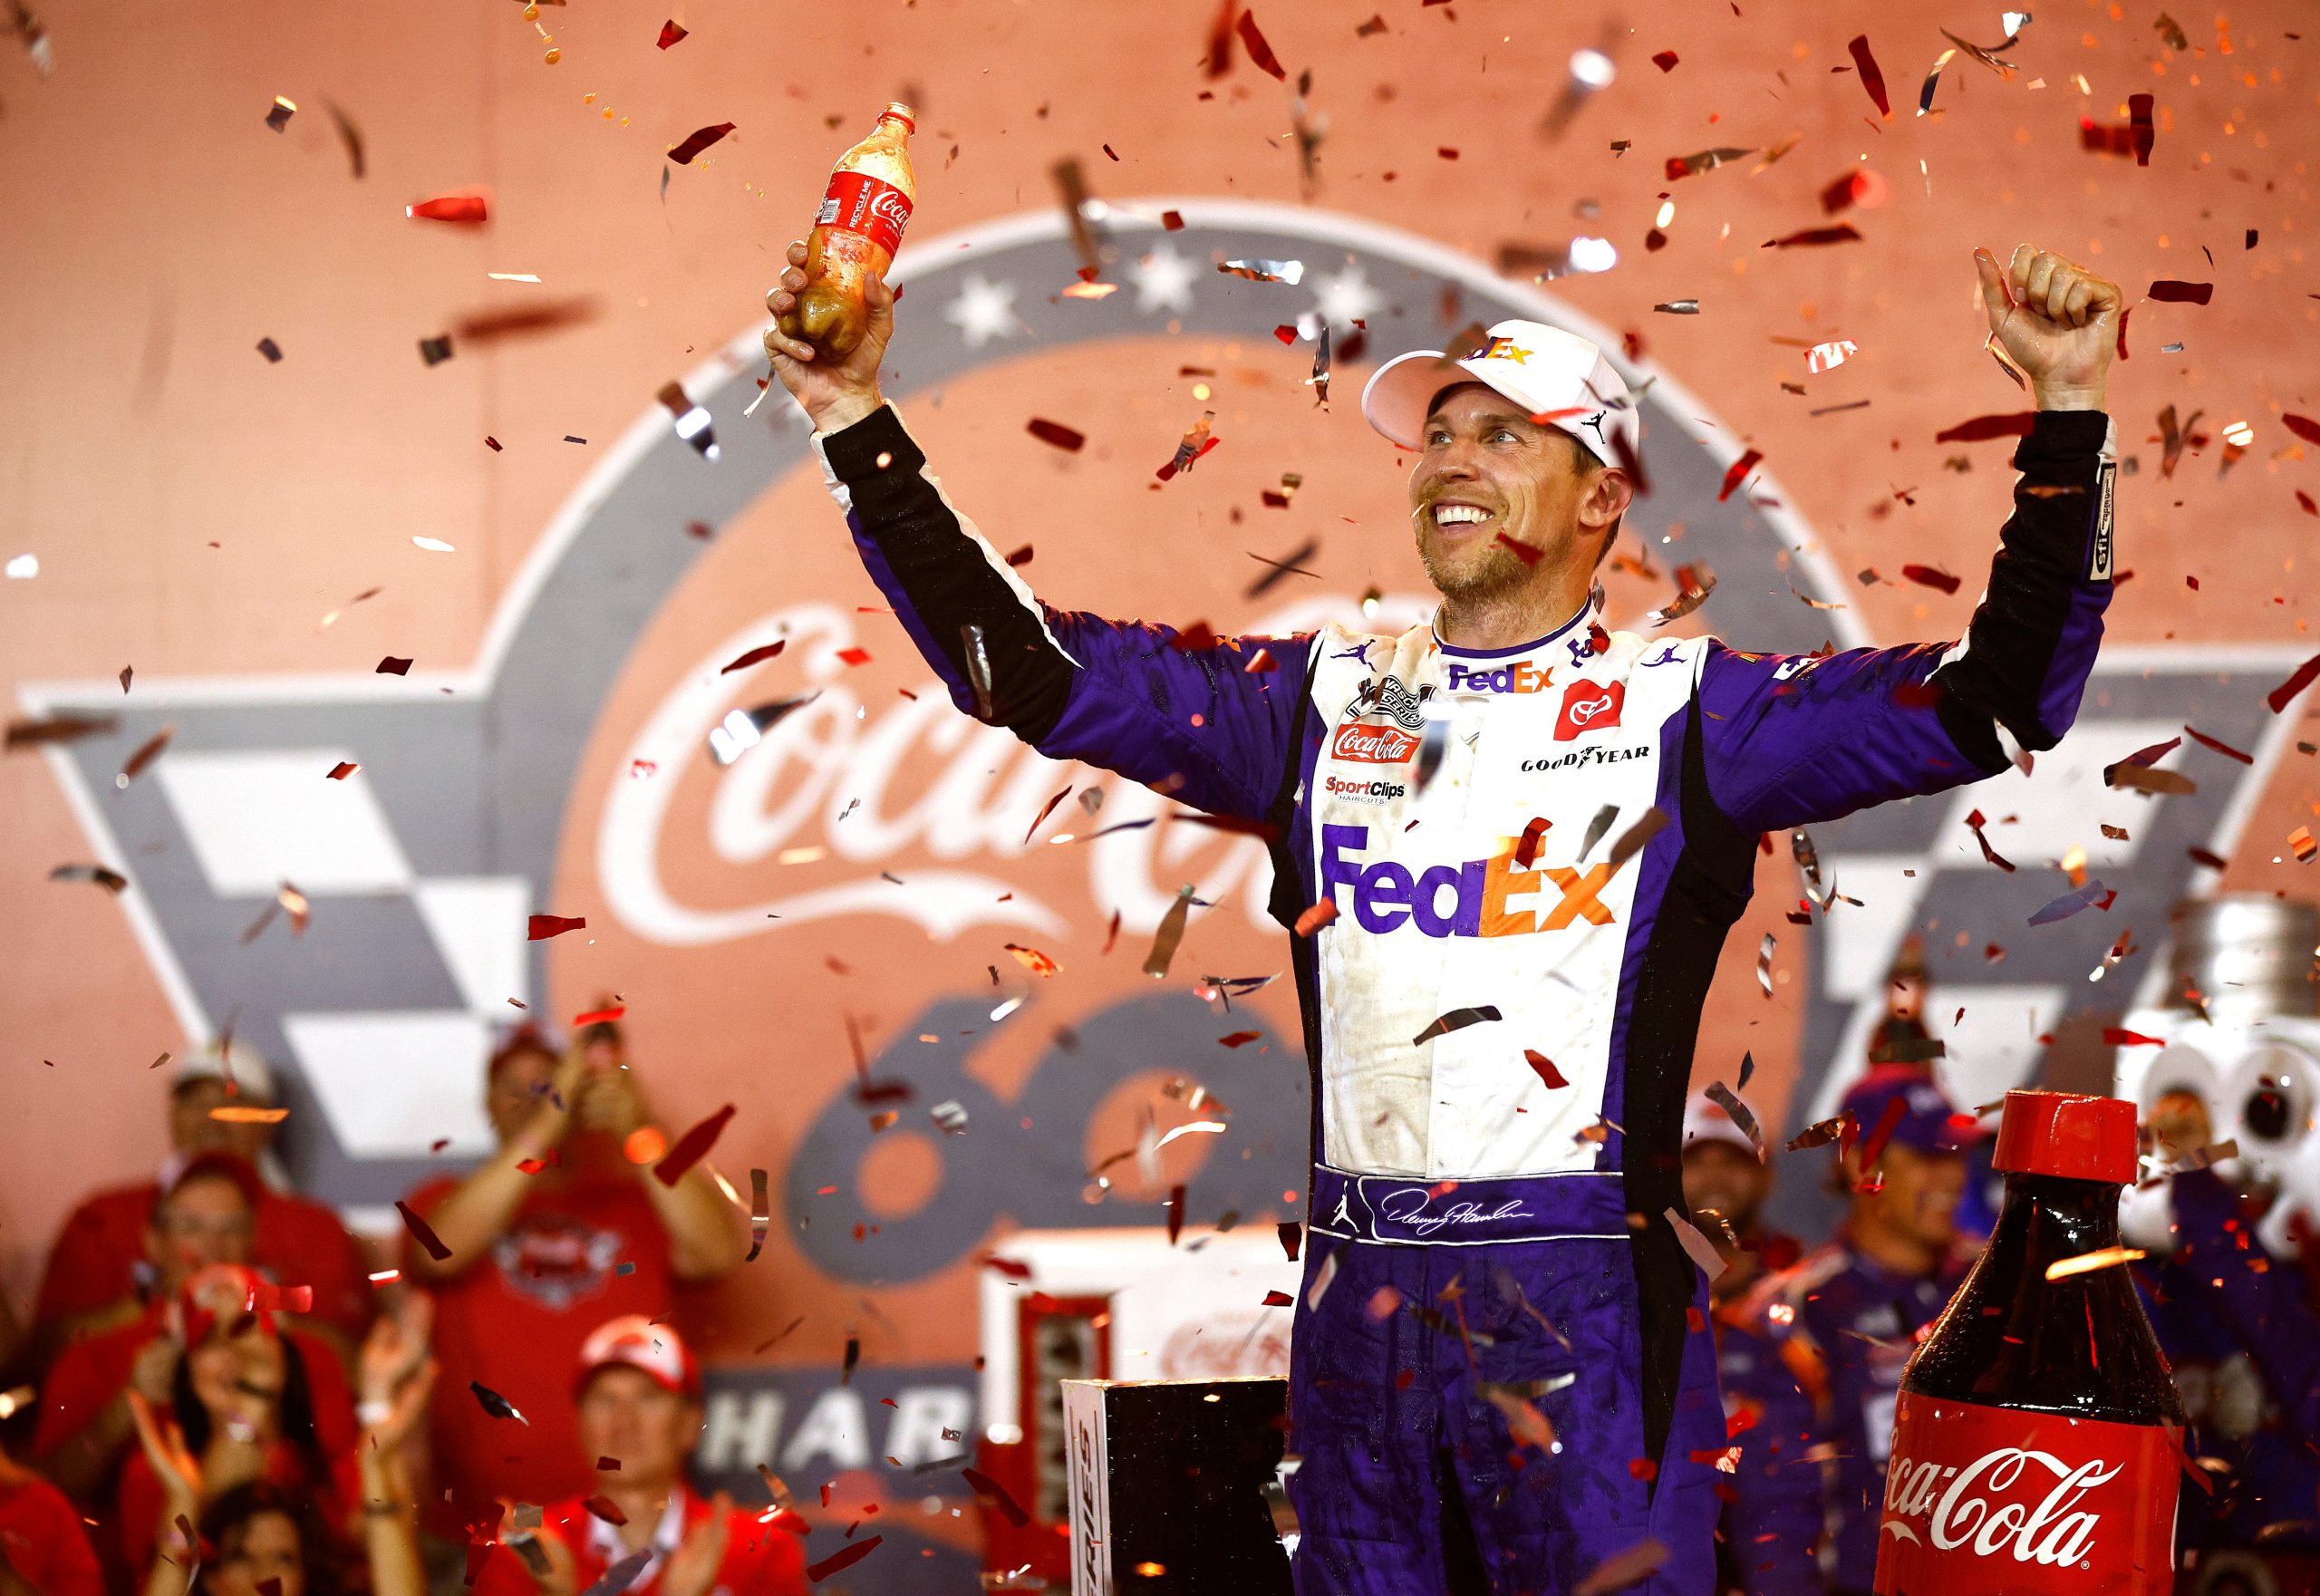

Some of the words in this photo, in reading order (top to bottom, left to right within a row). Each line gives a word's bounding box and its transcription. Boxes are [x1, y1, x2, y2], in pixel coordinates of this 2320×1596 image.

[849, 194, 867, 227] RECYCLE
[863, 179, 872, 193] ME
[1459, 336, 1535, 365] dEx
[1448, 660, 1555, 693] FedEx
[1521, 746, 1649, 771] GOODYEAR
[1325, 776, 1405, 799] SportClips
[1339, 794, 1386, 805] HAIRCUTS
[1320, 824, 1620, 938] FedEx
[696, 1388, 972, 1474] HAR
